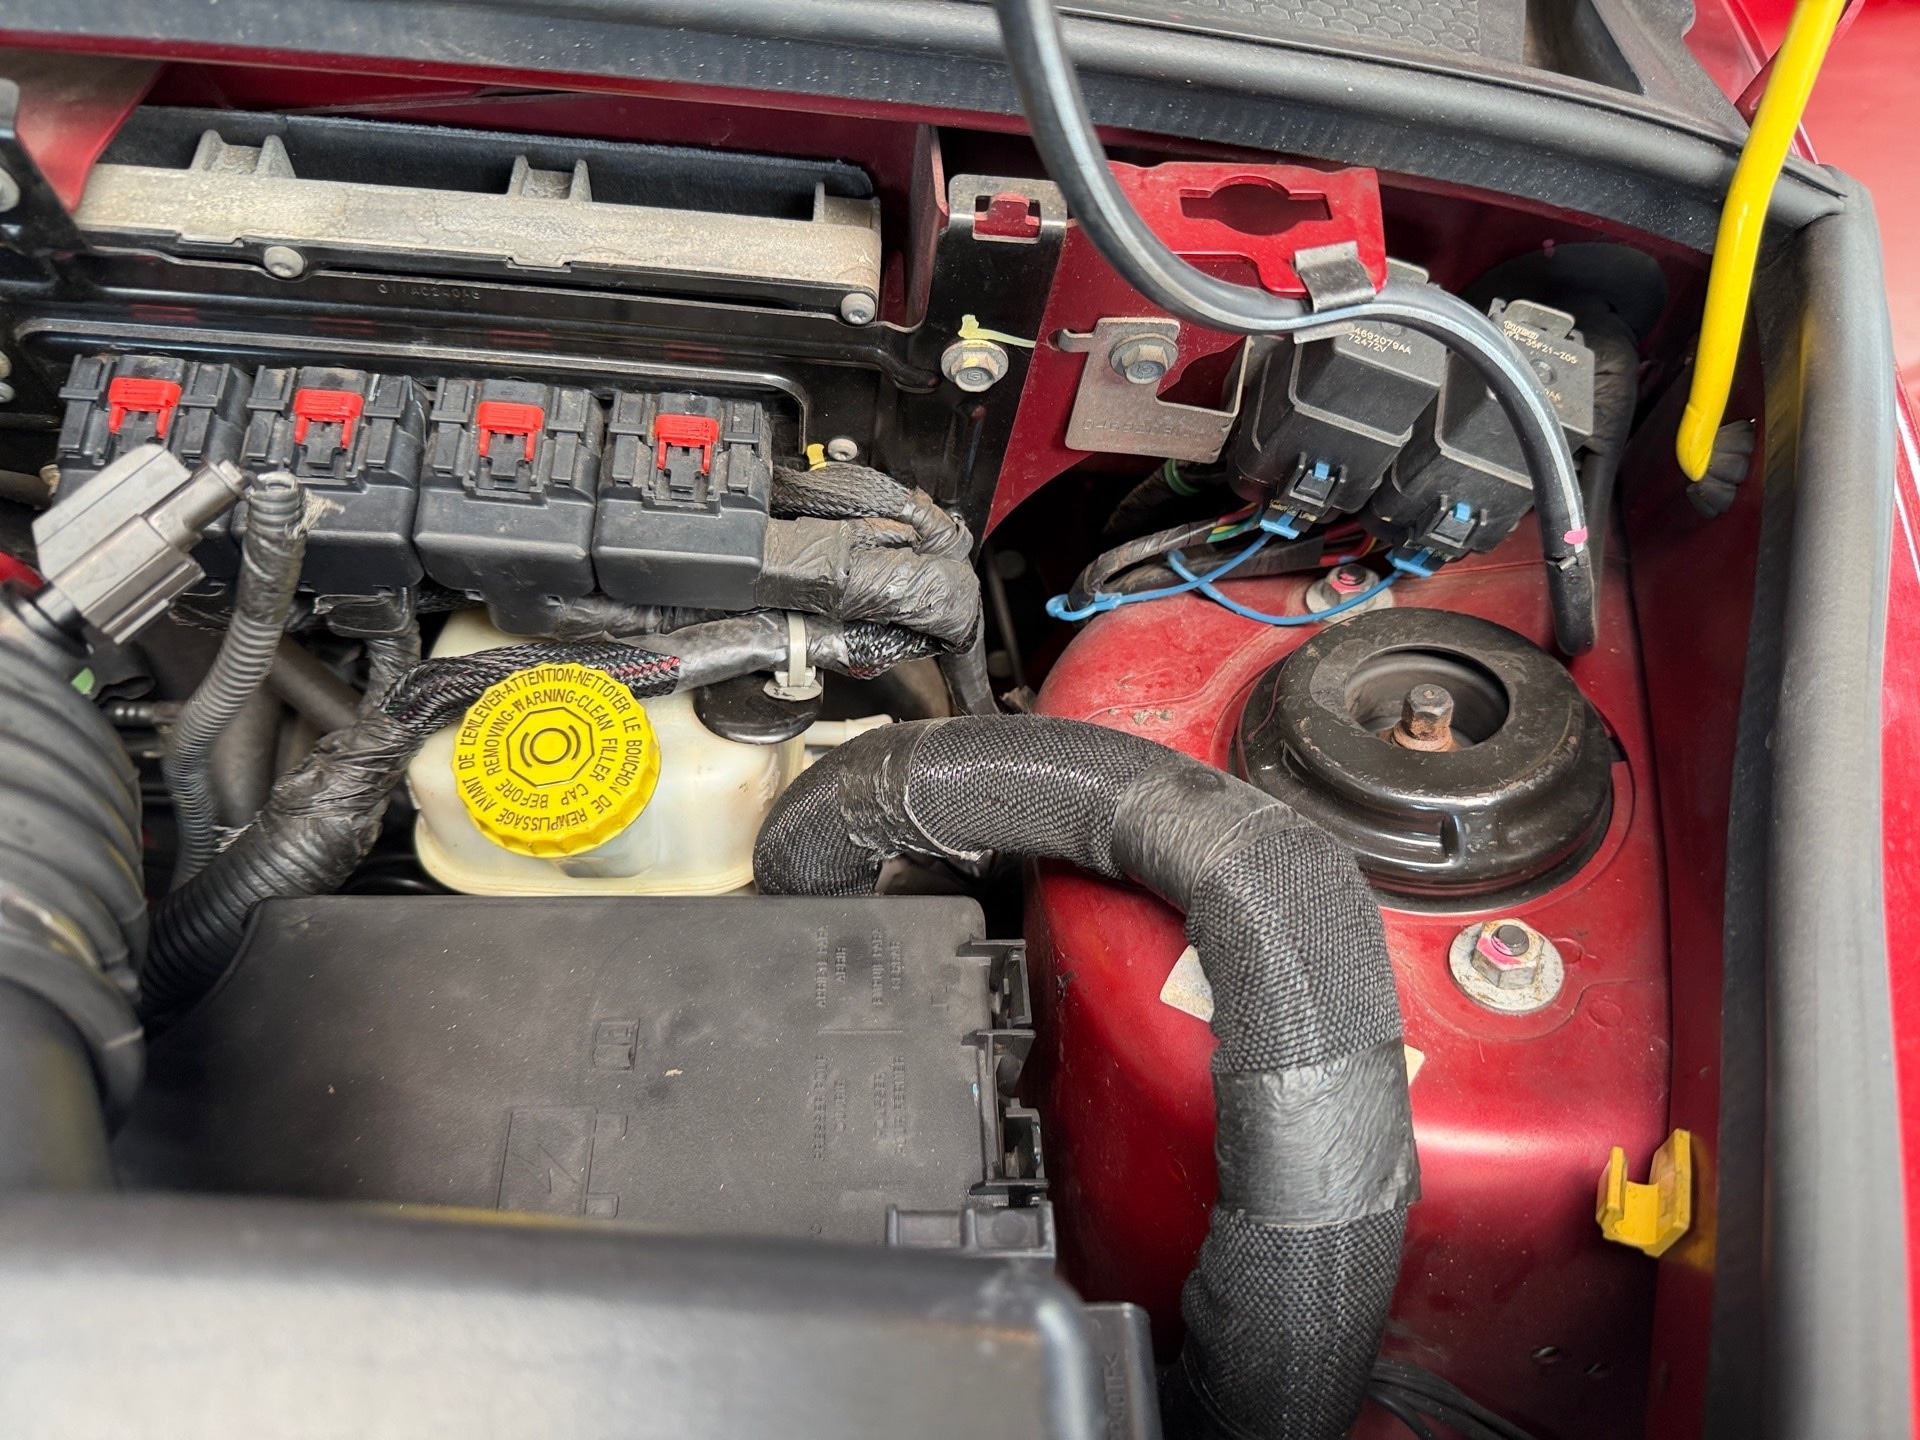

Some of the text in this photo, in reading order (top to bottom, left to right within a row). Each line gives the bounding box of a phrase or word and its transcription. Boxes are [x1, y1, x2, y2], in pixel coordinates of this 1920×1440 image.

[623, 716, 641, 733] LE
[458, 753, 475, 770] DE
[589, 738, 618, 783] FILLER
[610, 739, 643, 796] BOUCHON
[462, 777, 498, 812] AVANT
[495, 778, 549, 809] BEFORE
[561, 783, 589, 806] CAP
[590, 794, 612, 815] DE
[495, 808, 588, 832] REMPLISSAGE
